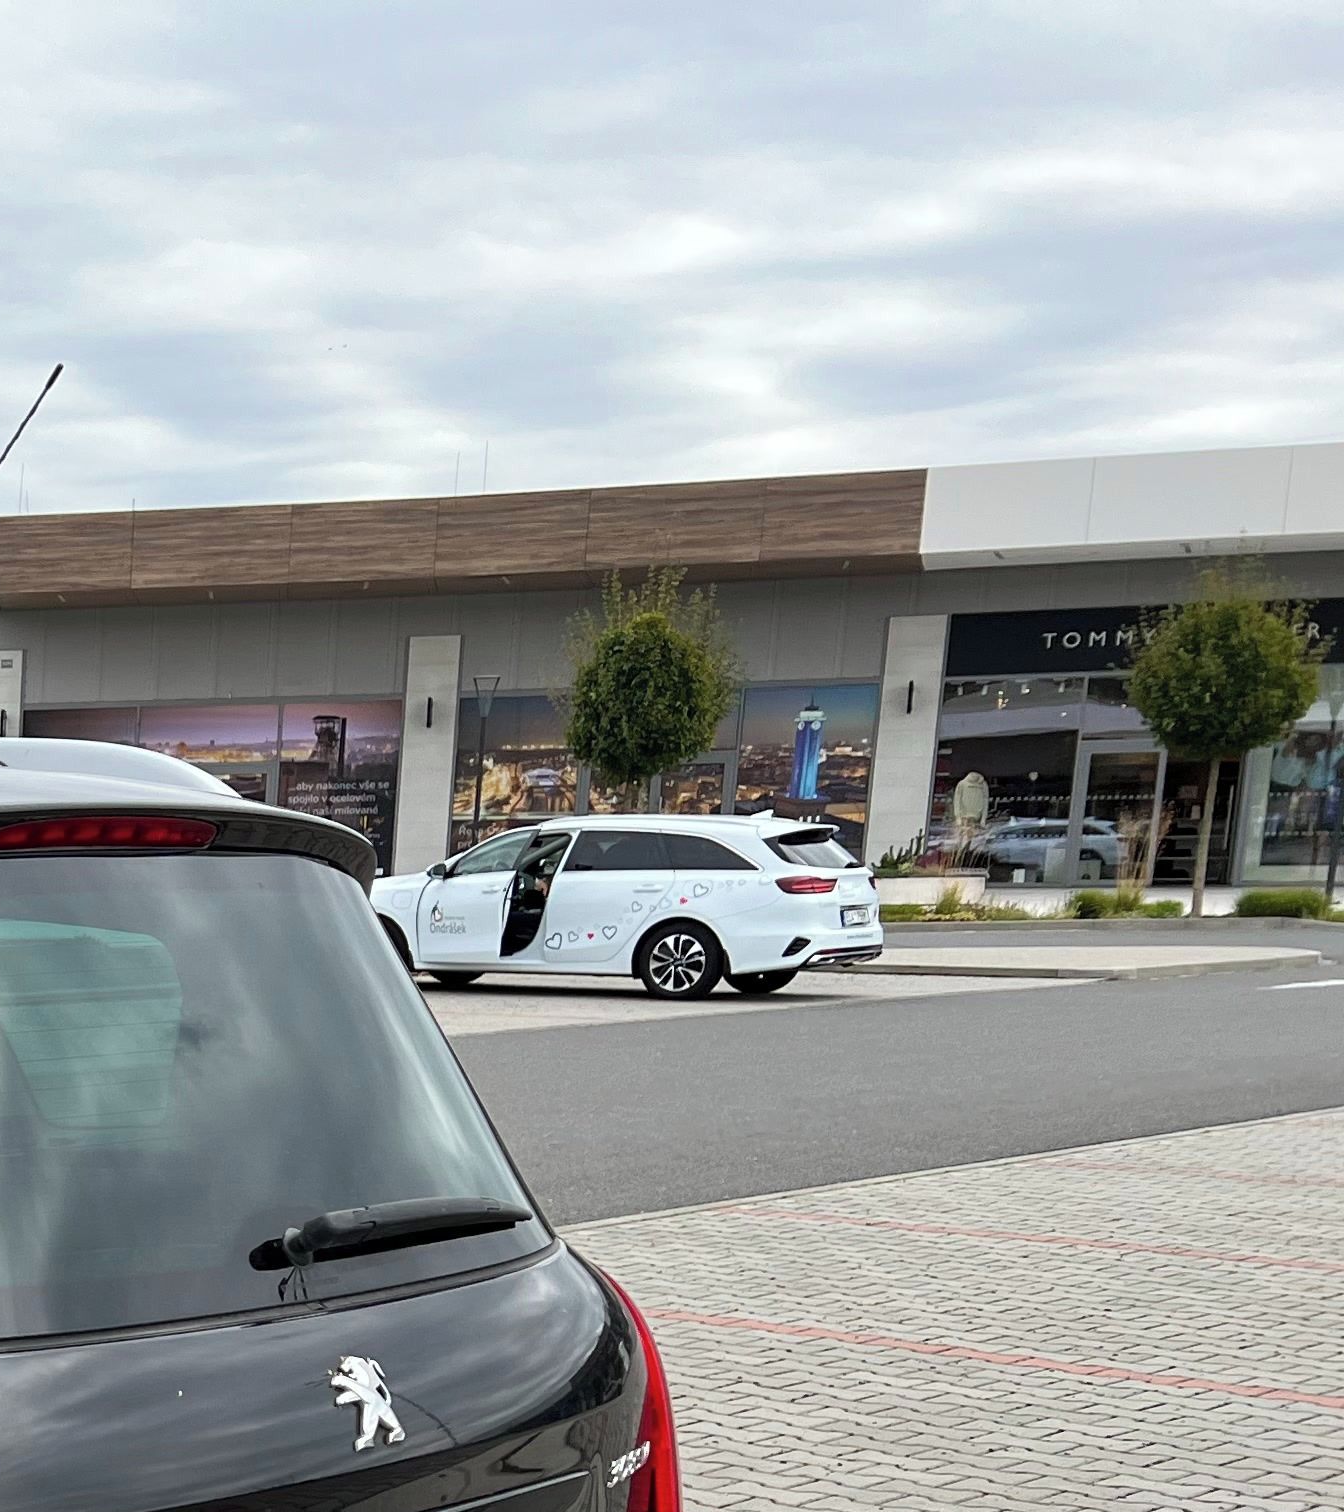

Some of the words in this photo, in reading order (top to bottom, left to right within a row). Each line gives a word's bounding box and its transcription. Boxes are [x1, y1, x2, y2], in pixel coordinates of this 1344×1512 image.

[1042, 628, 1156, 649] TOMMY
[315, 781, 357, 790] nakonec
[358, 781, 376, 790] vše
[378, 780, 390, 790] se
